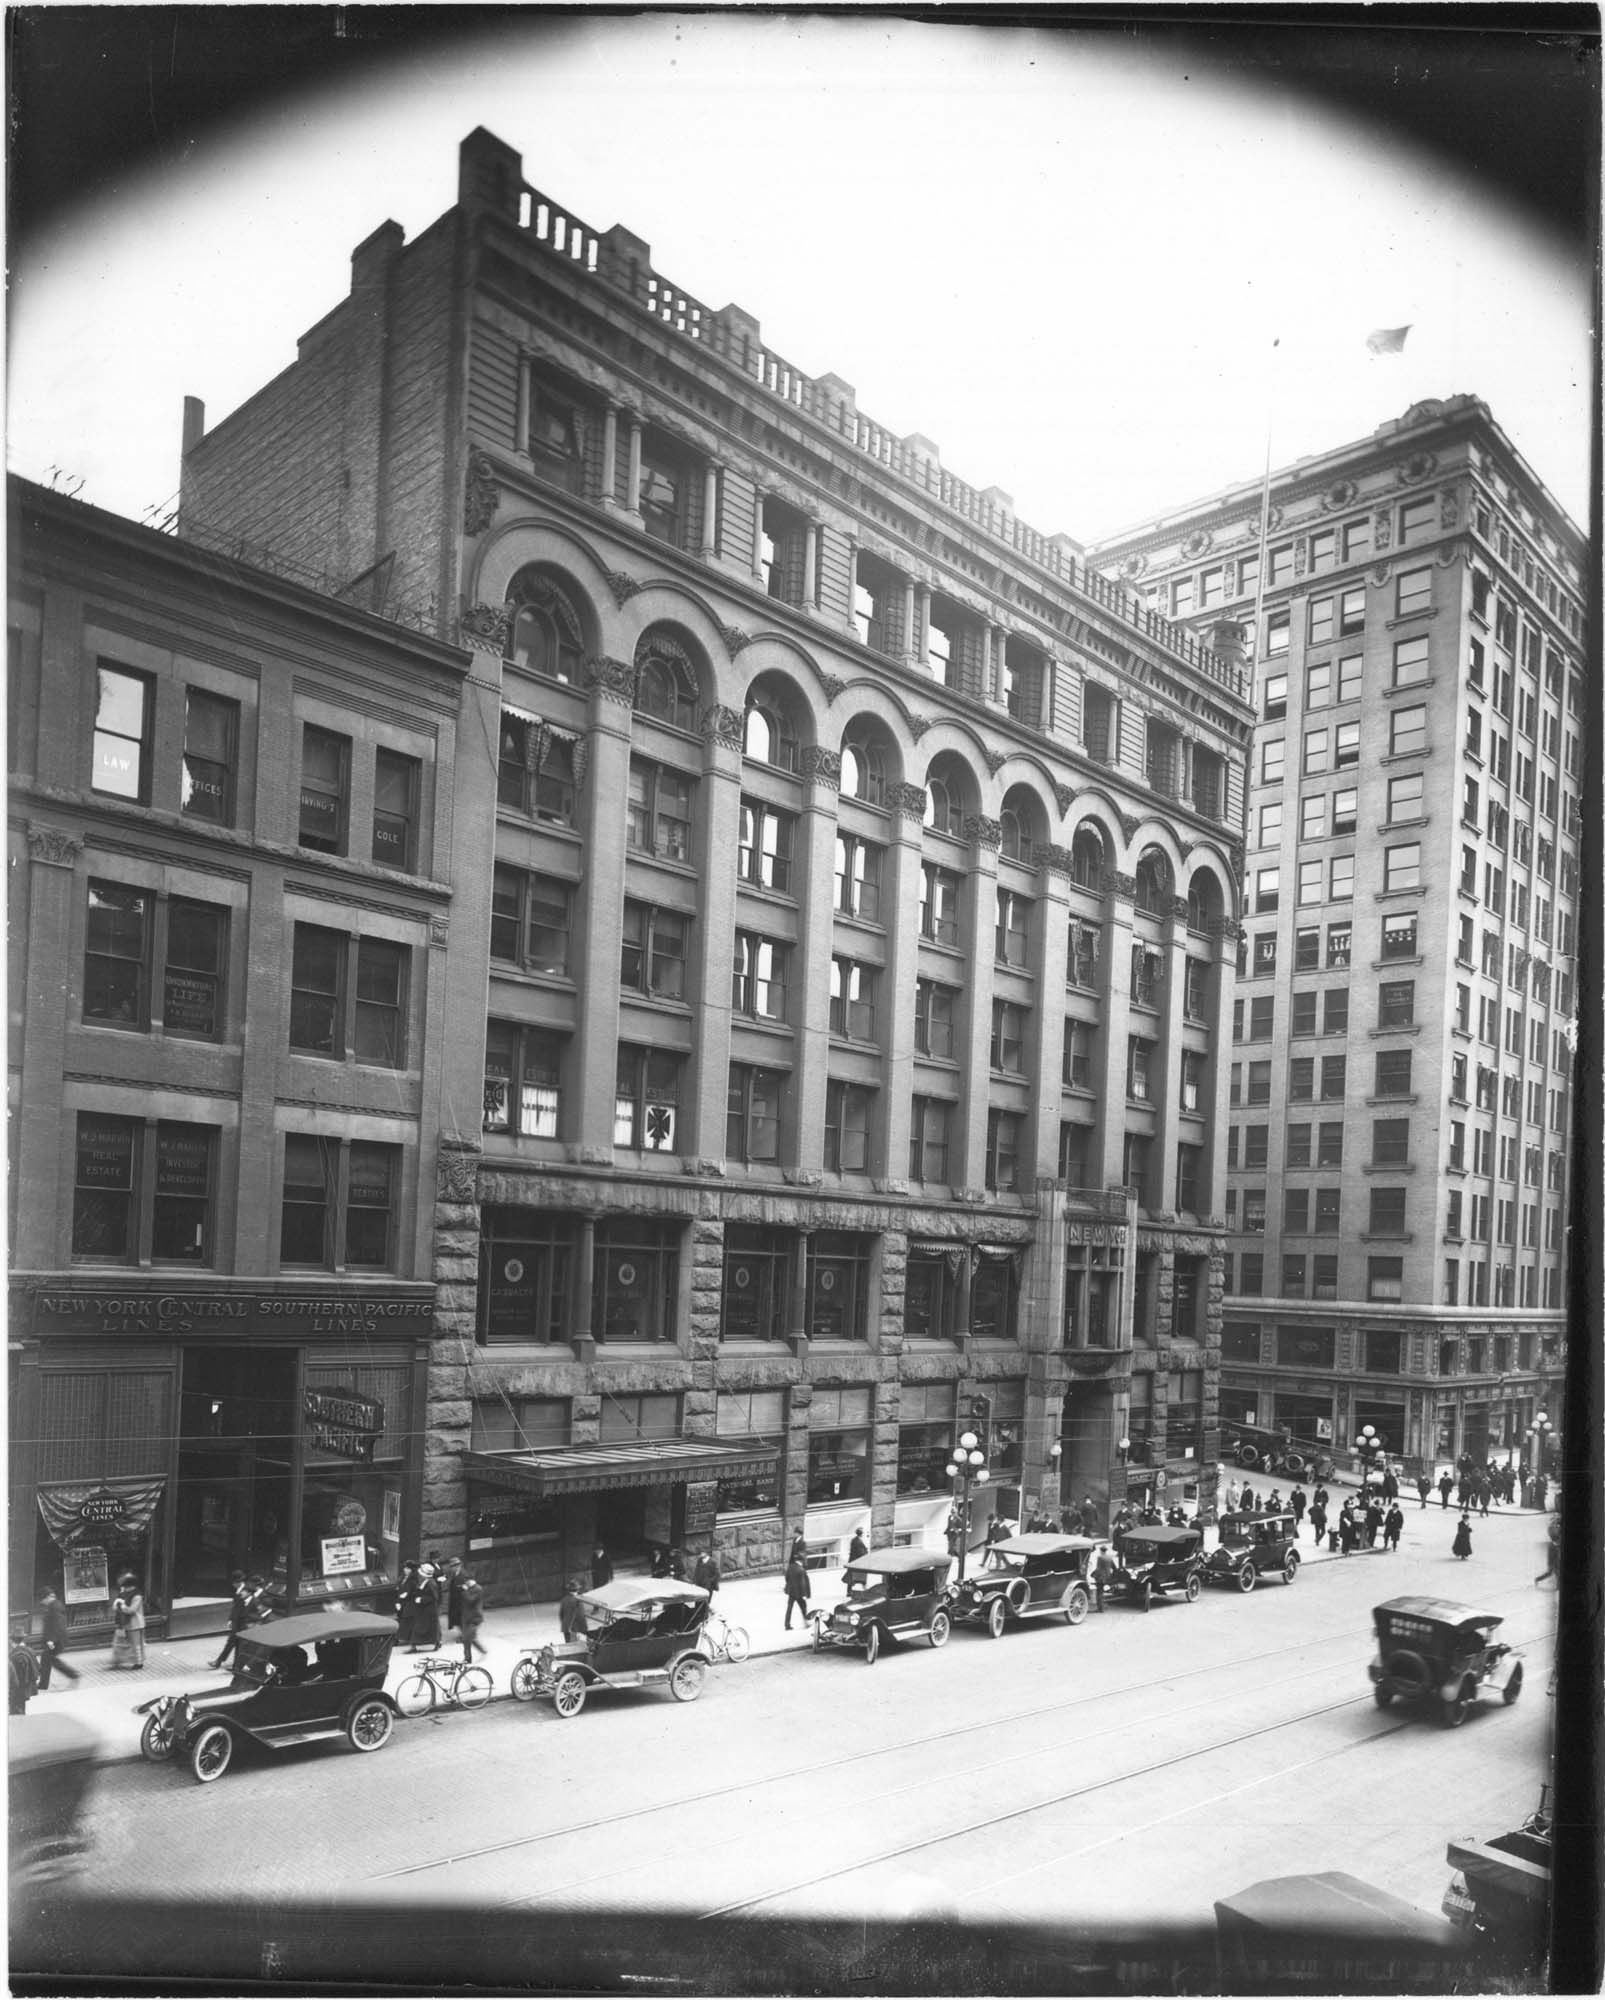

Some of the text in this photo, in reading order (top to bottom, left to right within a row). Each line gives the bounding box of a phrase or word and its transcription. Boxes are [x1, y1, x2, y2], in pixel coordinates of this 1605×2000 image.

[103, 752, 130, 772] LAW
[184, 777, 223, 797] FFICES
[376, 830, 400, 844] COLE
[86, 1166, 123, 1177] ESTATE
[42, 1297, 433, 1320] NEW YORK CENTRAL SOUTHERN PACIFIC
[103, 1318, 378, 1332] LINES LINES
[81, 1505, 123, 1517] CENTRAL
